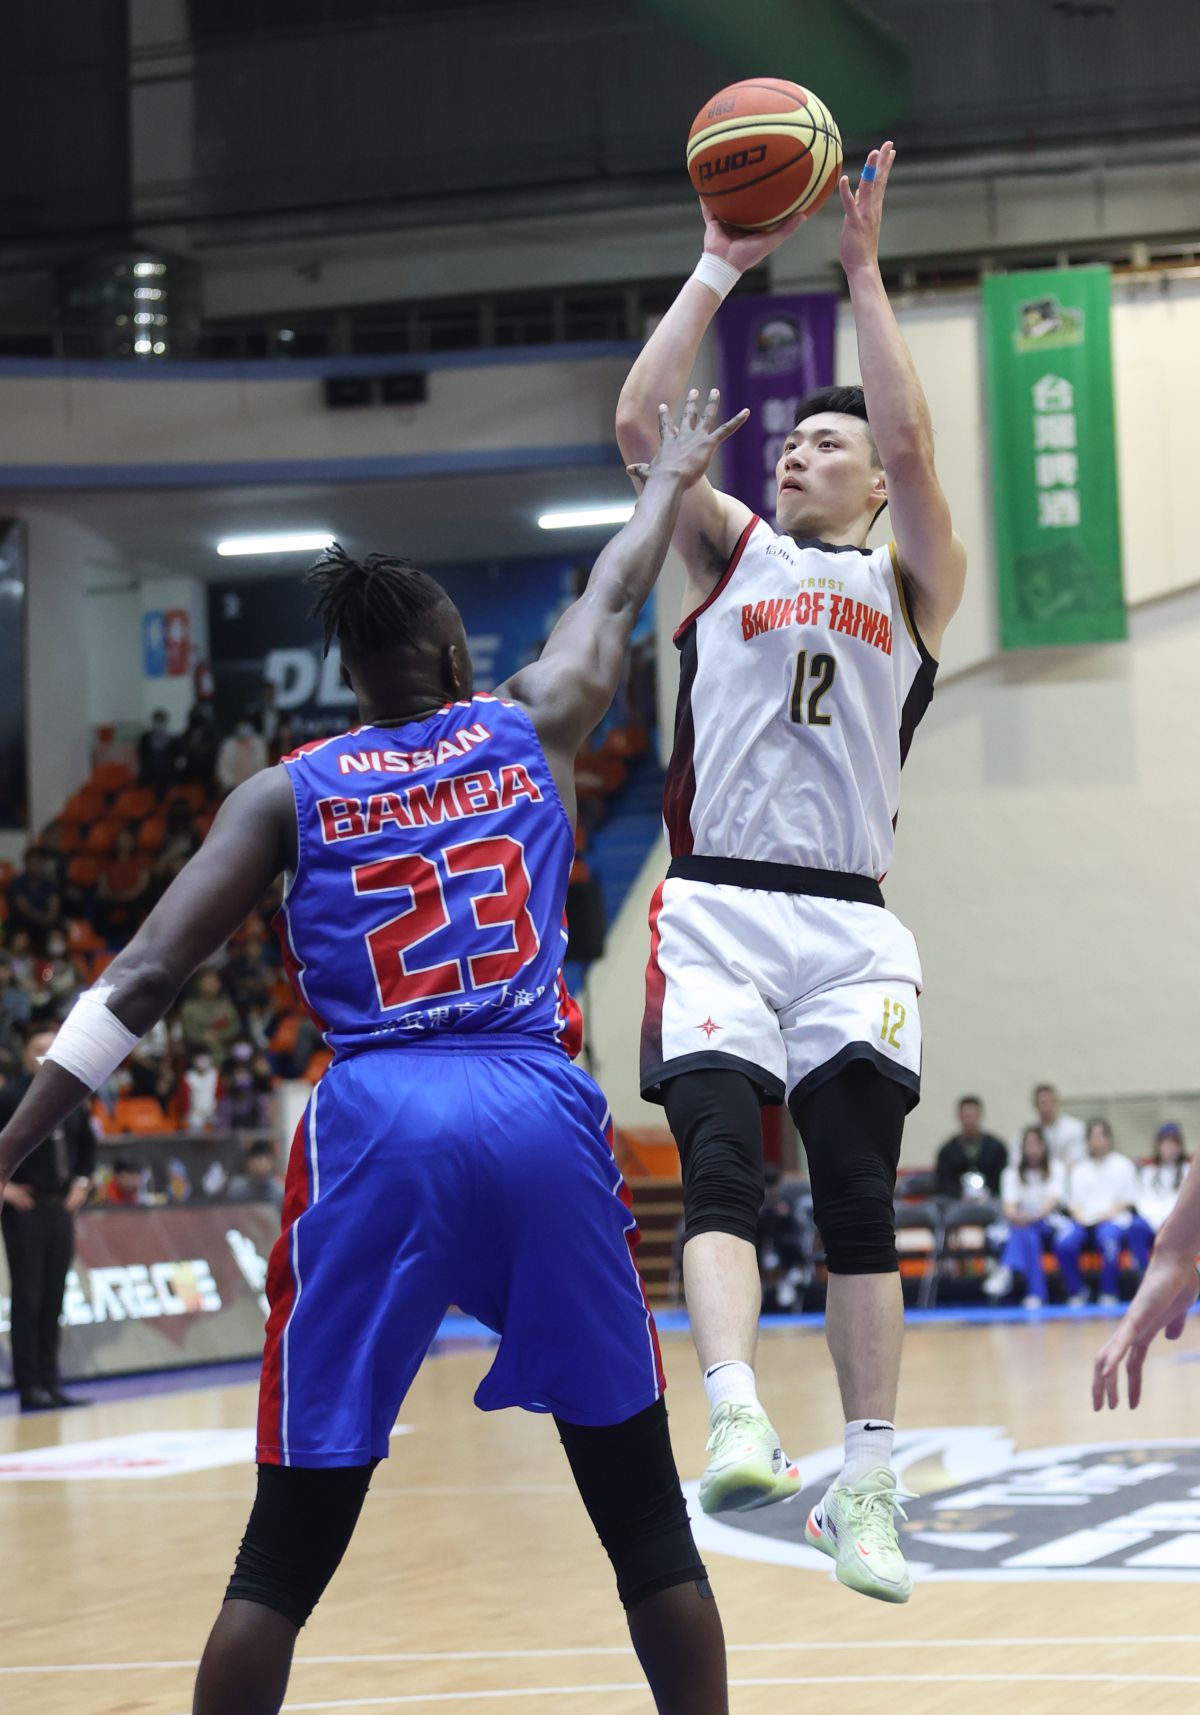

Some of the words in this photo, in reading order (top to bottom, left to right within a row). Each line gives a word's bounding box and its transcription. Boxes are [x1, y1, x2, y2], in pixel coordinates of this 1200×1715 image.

[699, 144, 767, 186] conti
[800, 577, 844, 592] TRUST
[741, 598, 796, 642] BANK
[795, 592, 825, 626] OF
[789, 647, 836, 726] 12
[338, 722, 493, 775] NISSAN
[316, 764, 544, 844] BAMBA
[351, 834, 541, 1012] 23
[880, 996, 906, 1049] 12
